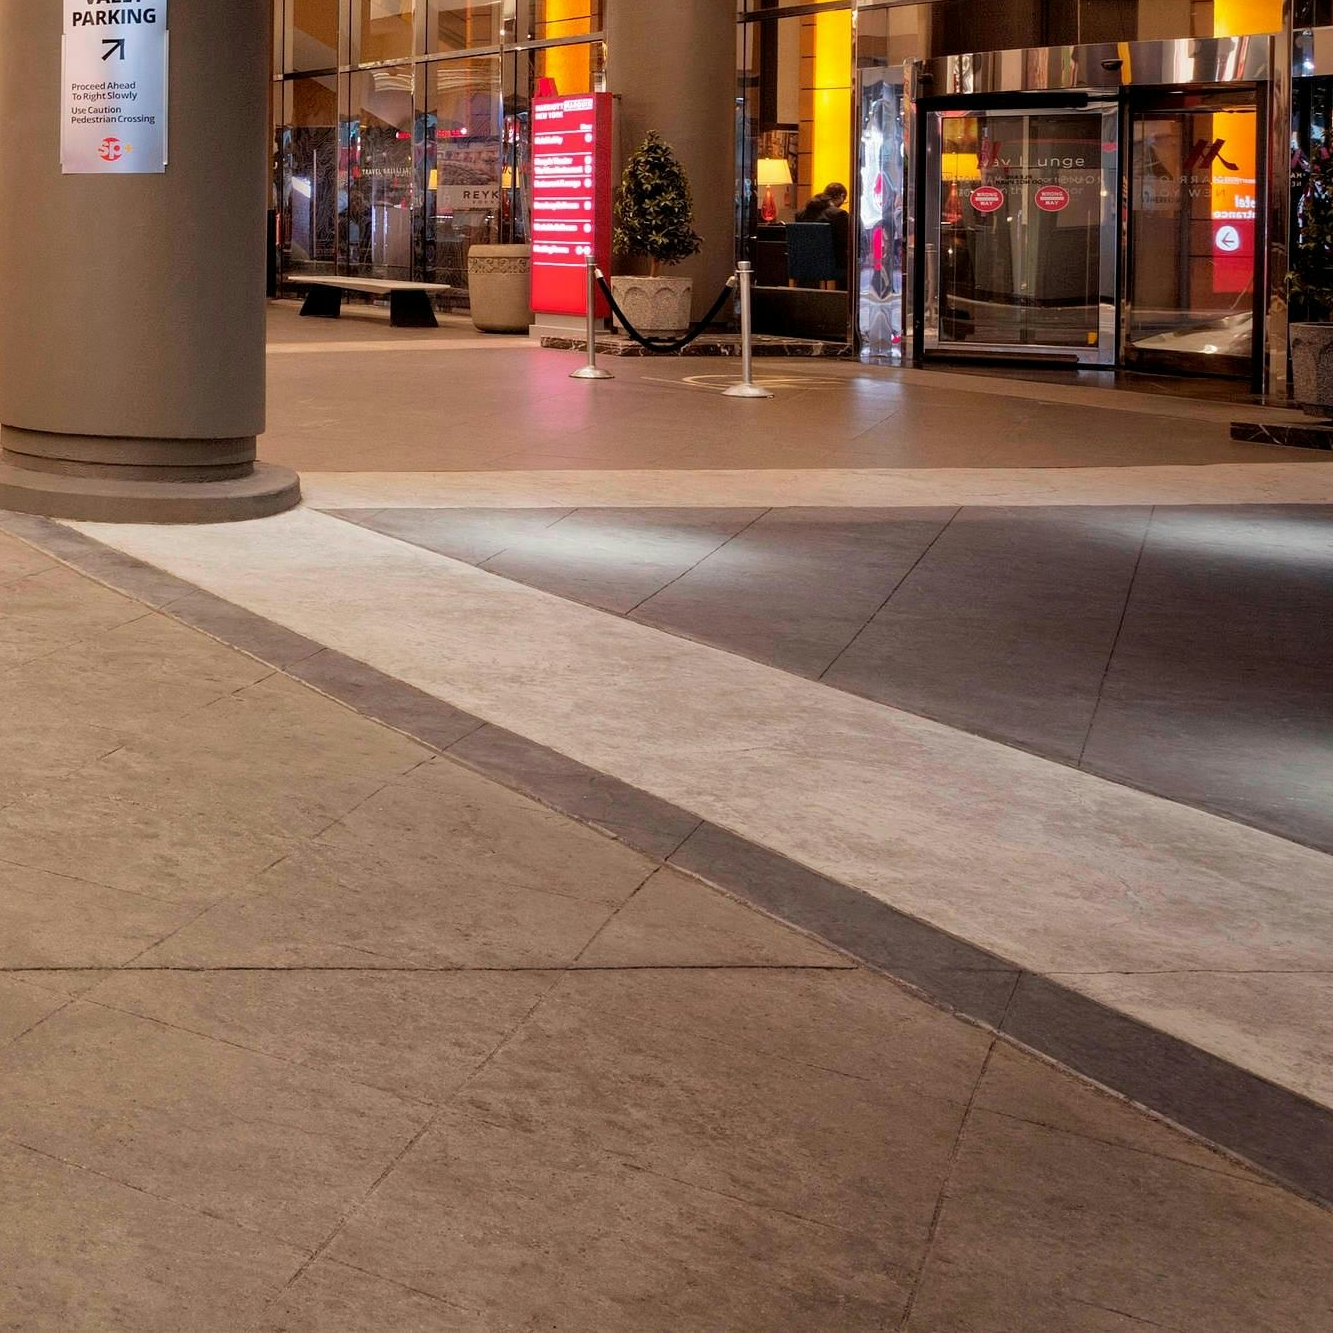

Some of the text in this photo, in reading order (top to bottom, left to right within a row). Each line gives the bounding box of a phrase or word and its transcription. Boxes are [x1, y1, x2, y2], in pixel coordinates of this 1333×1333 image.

[72, 8, 156, 27] PARKING
[71, 82, 106, 90] Proceed
[72, 91, 138, 102] To Right Slowly
[71, 106, 122, 114] Use Caution
[71, 114, 155, 125] Pedestrian Crossing
